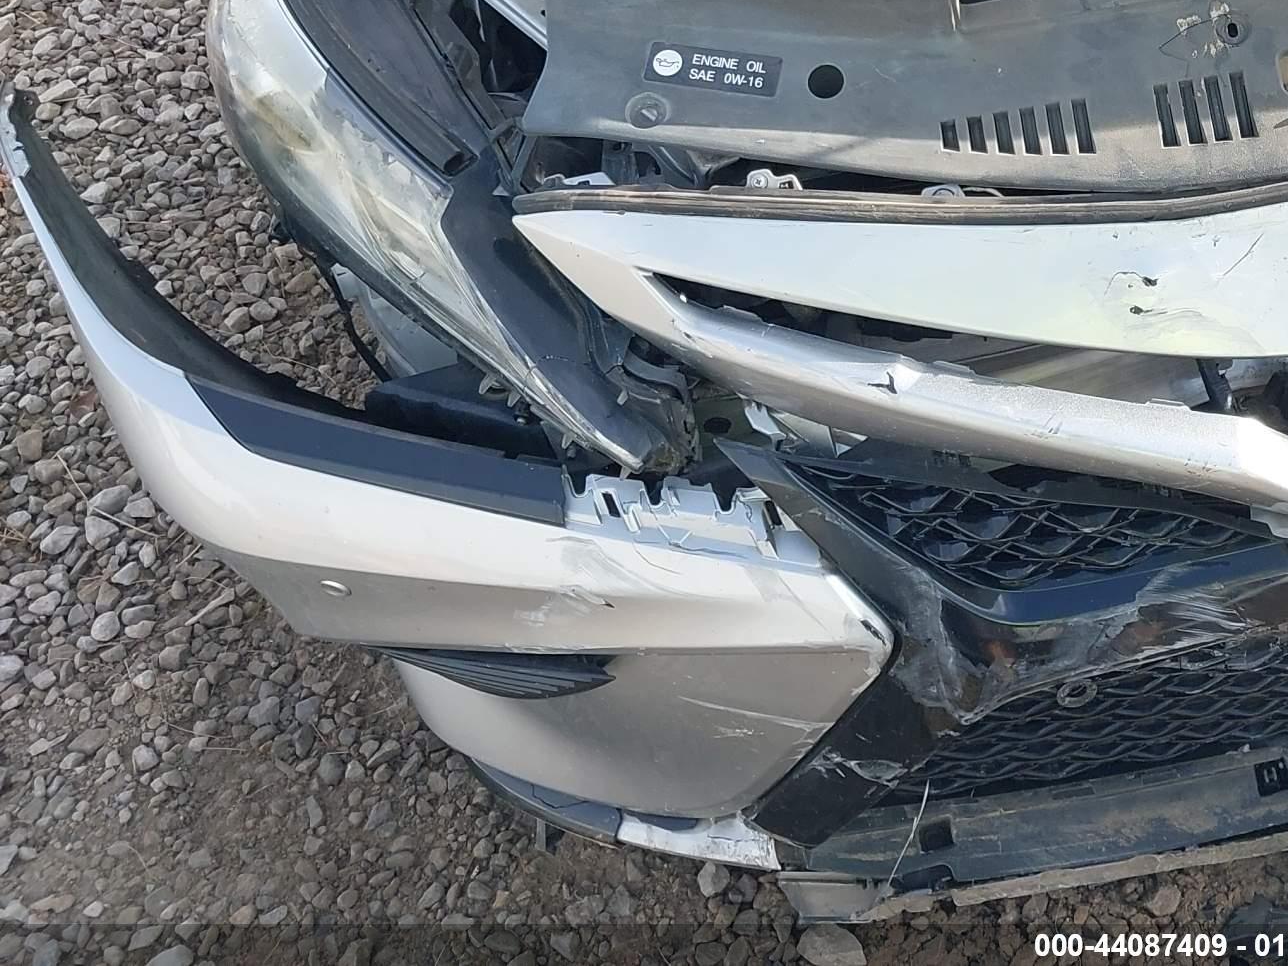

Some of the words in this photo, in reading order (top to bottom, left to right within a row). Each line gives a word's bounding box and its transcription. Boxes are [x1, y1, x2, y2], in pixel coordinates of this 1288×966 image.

[692, 53, 739, 70] ENGINE
[746, 60, 766, 74] OIL
[688, 68, 716, 82] SAE
[724, 72, 764, 88] 0W-16
